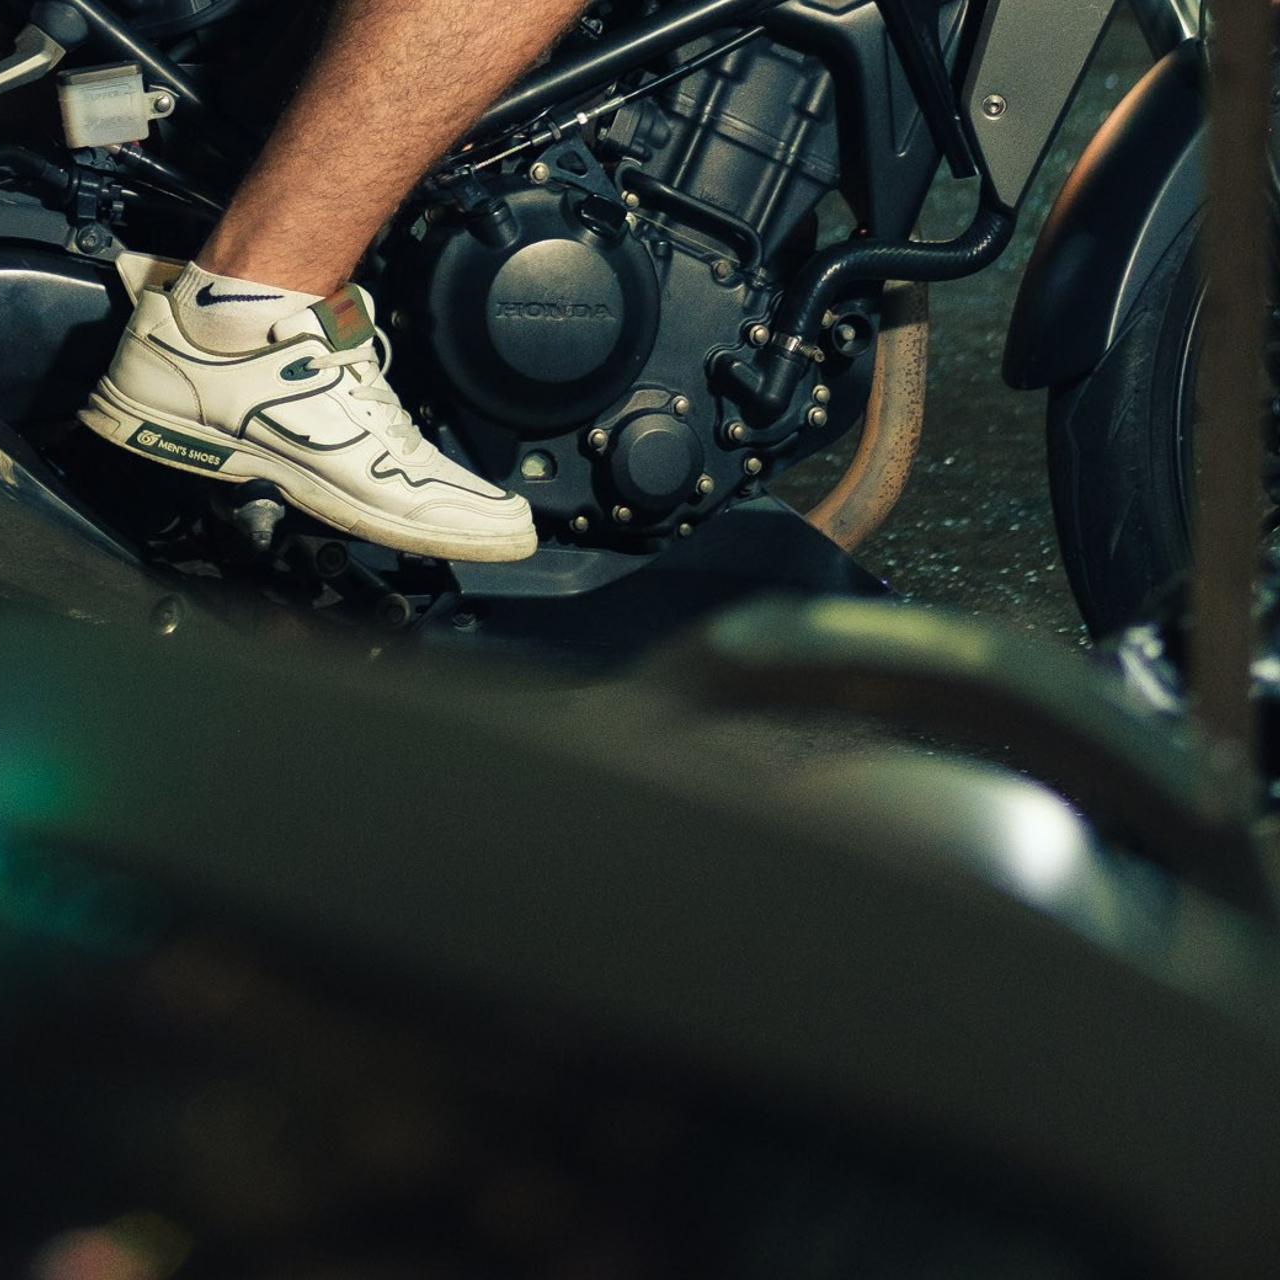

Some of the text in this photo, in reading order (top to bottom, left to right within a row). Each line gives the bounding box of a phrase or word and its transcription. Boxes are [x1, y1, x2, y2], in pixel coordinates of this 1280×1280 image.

[495, 301, 617, 322] HONDA
[157, 439, 221, 466] MEN'S SHOES
